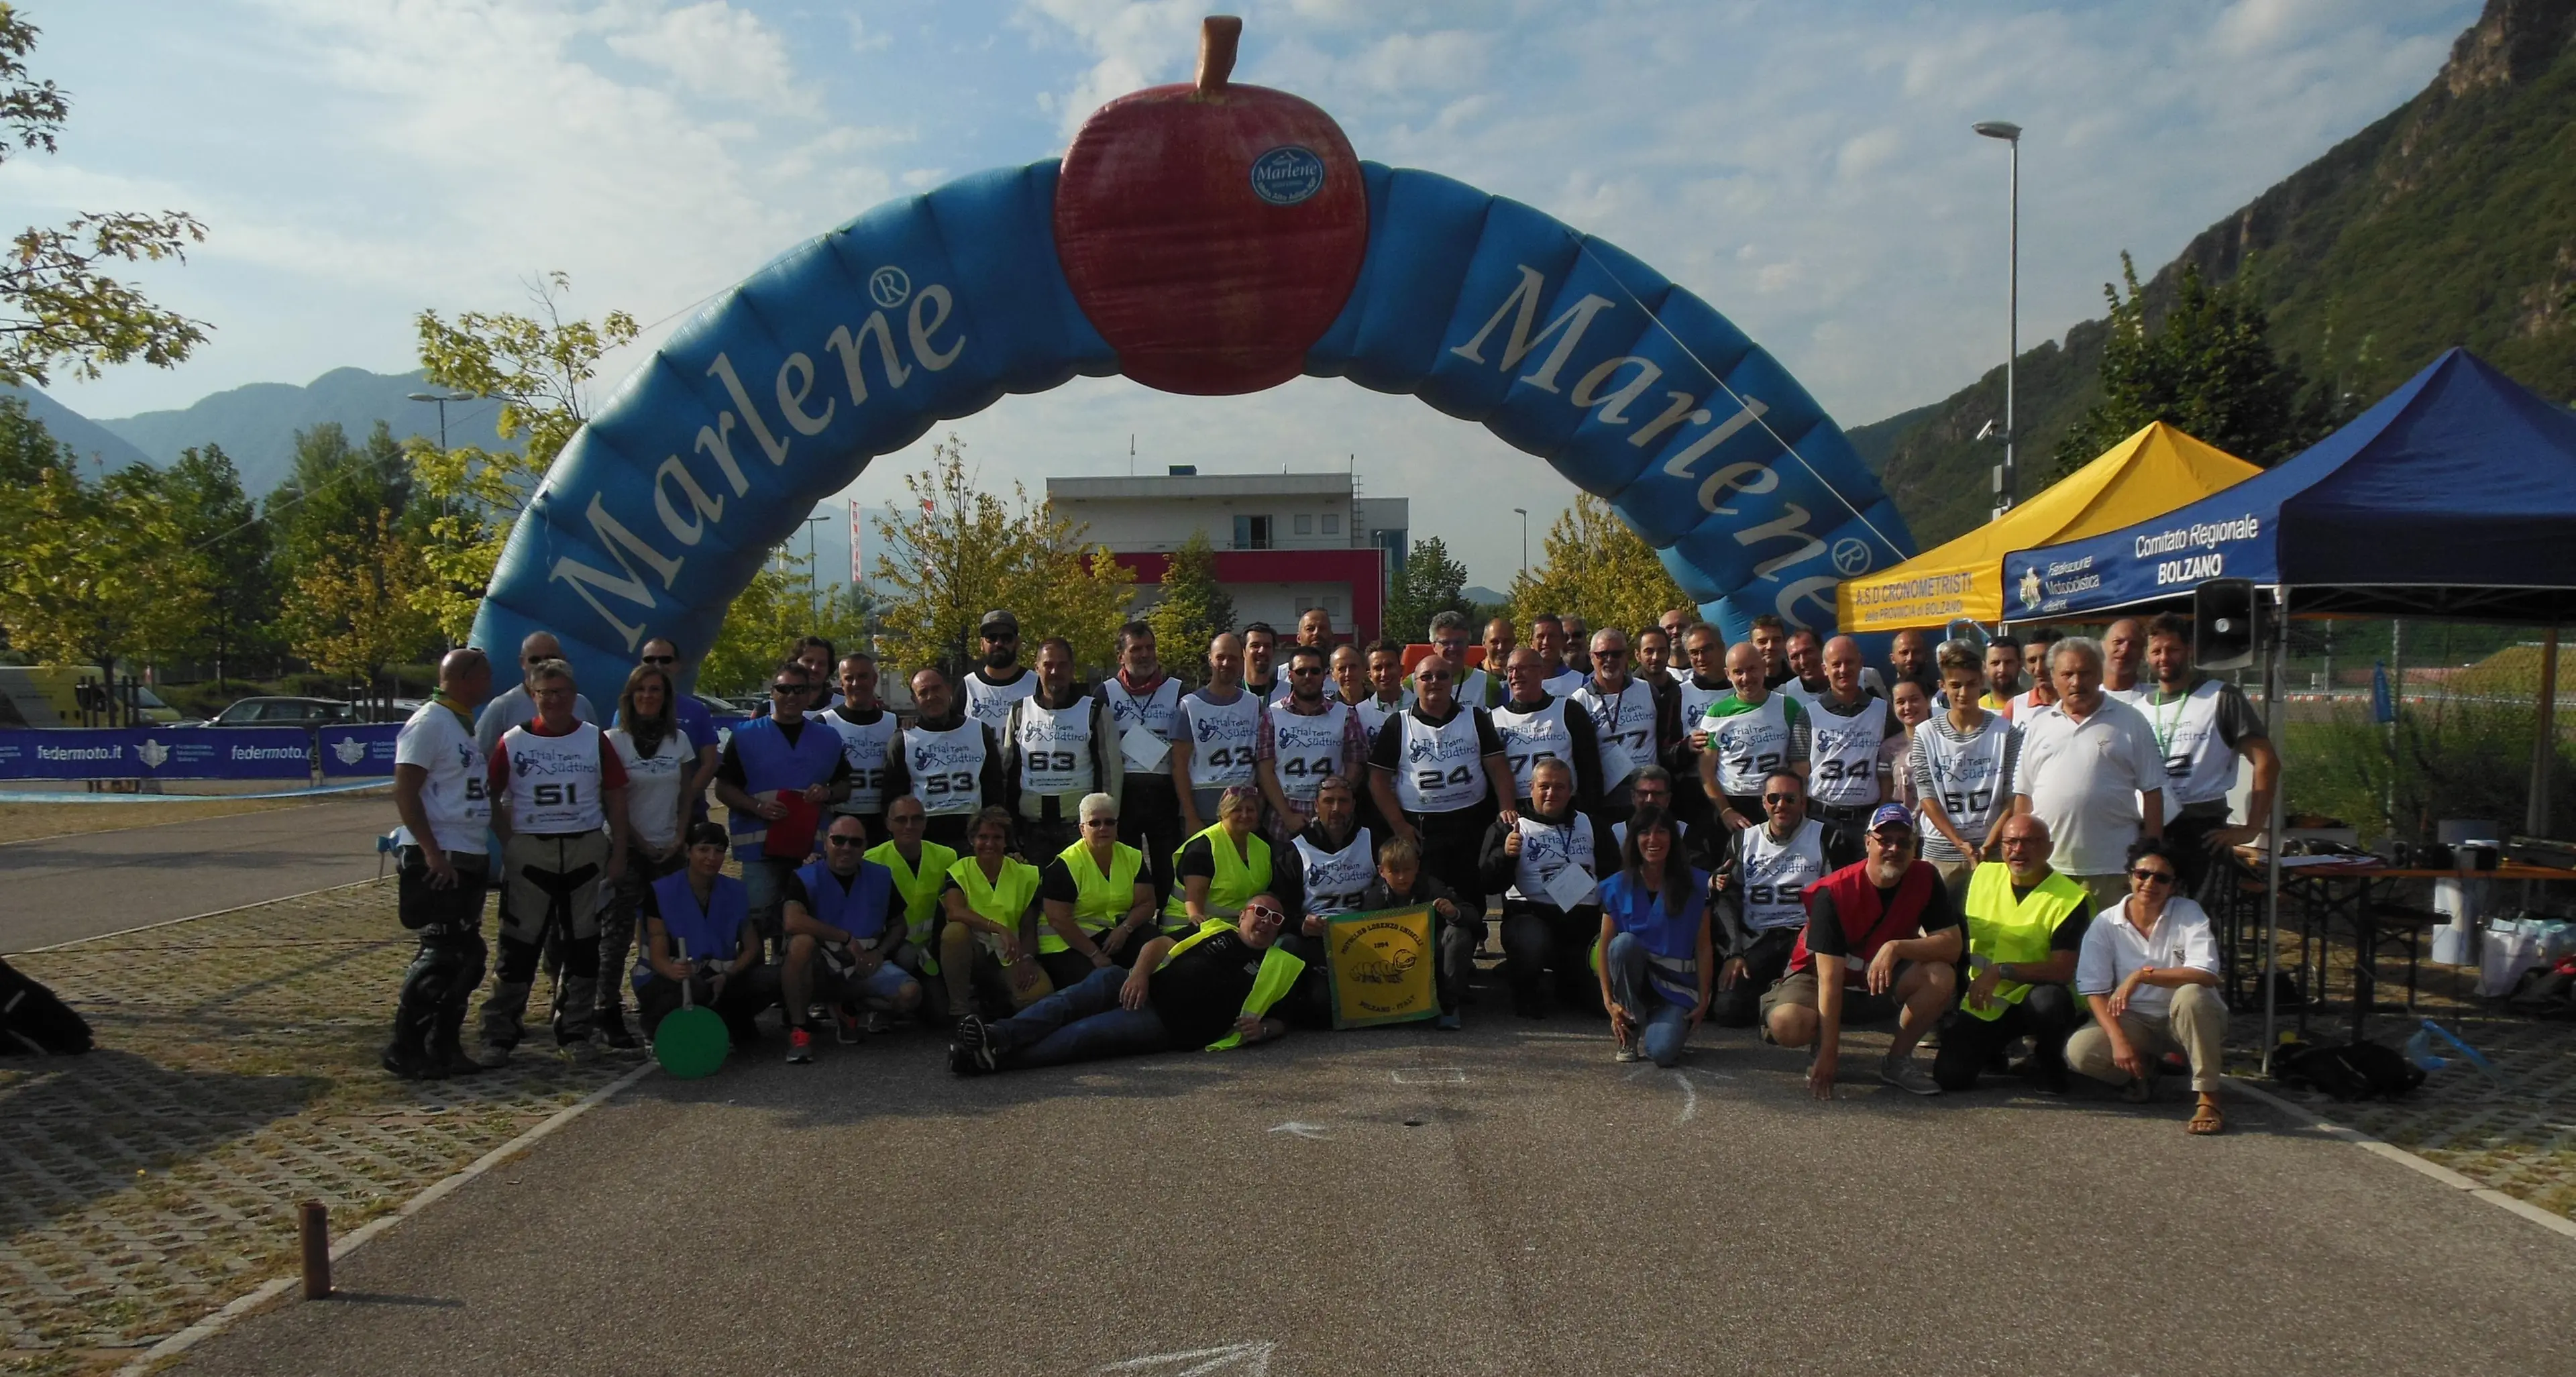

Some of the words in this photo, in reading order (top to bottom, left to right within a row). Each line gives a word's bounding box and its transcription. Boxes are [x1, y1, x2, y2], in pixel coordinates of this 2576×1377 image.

[1450, 264, 1837, 629] Marlene
[549, 284, 967, 653] Marlene
[2135, 529, 2186, 558] Comitato
[2190, 513, 2260, 549] Regionale
[2157, 553, 2222, 585] BOLZANO
[1882, 571, 1972, 603] CRONOMETRISTI
[1036, 720, 1054, 730] Trial
[1210, 716, 1230, 726] Trial
[1049, 731, 1088, 742] Südtirol
[1291, 726, 1311, 736] Trial
[1511, 724, 1532, 734] Trial
[1528, 731, 1566, 742] Südtirol
[1731, 724, 1753, 736] Trial
[1754, 725, 1773, 734] Team
[847, 736, 869, 747] Trial
[928, 742, 949, 753] Trial
[1444, 738, 1464, 748] Team
[37, 745, 121, 760] federmoto.it
[529, 749, 555, 760] Trial
[1209, 745, 1254, 767] 43
[1028, 750, 1077, 772] 63
[1284, 756, 1334, 778] 44
[1731, 751, 1781, 775] 72
[1941, 754, 1966, 767] Trial
[1968, 757, 1991, 766] Team
[1819, 759, 1872, 781] 34
[925, 771, 974, 795] 53
[1417, 765, 1474, 791] 24
[534, 782, 577, 806] 51
[1945, 788, 1993, 814] 60
[1540, 834, 1562, 845] Tria
[1322, 860, 1342, 871] Trial
[1776, 861, 1819, 875] Südtirol
[1749, 883, 1805, 905] 65
